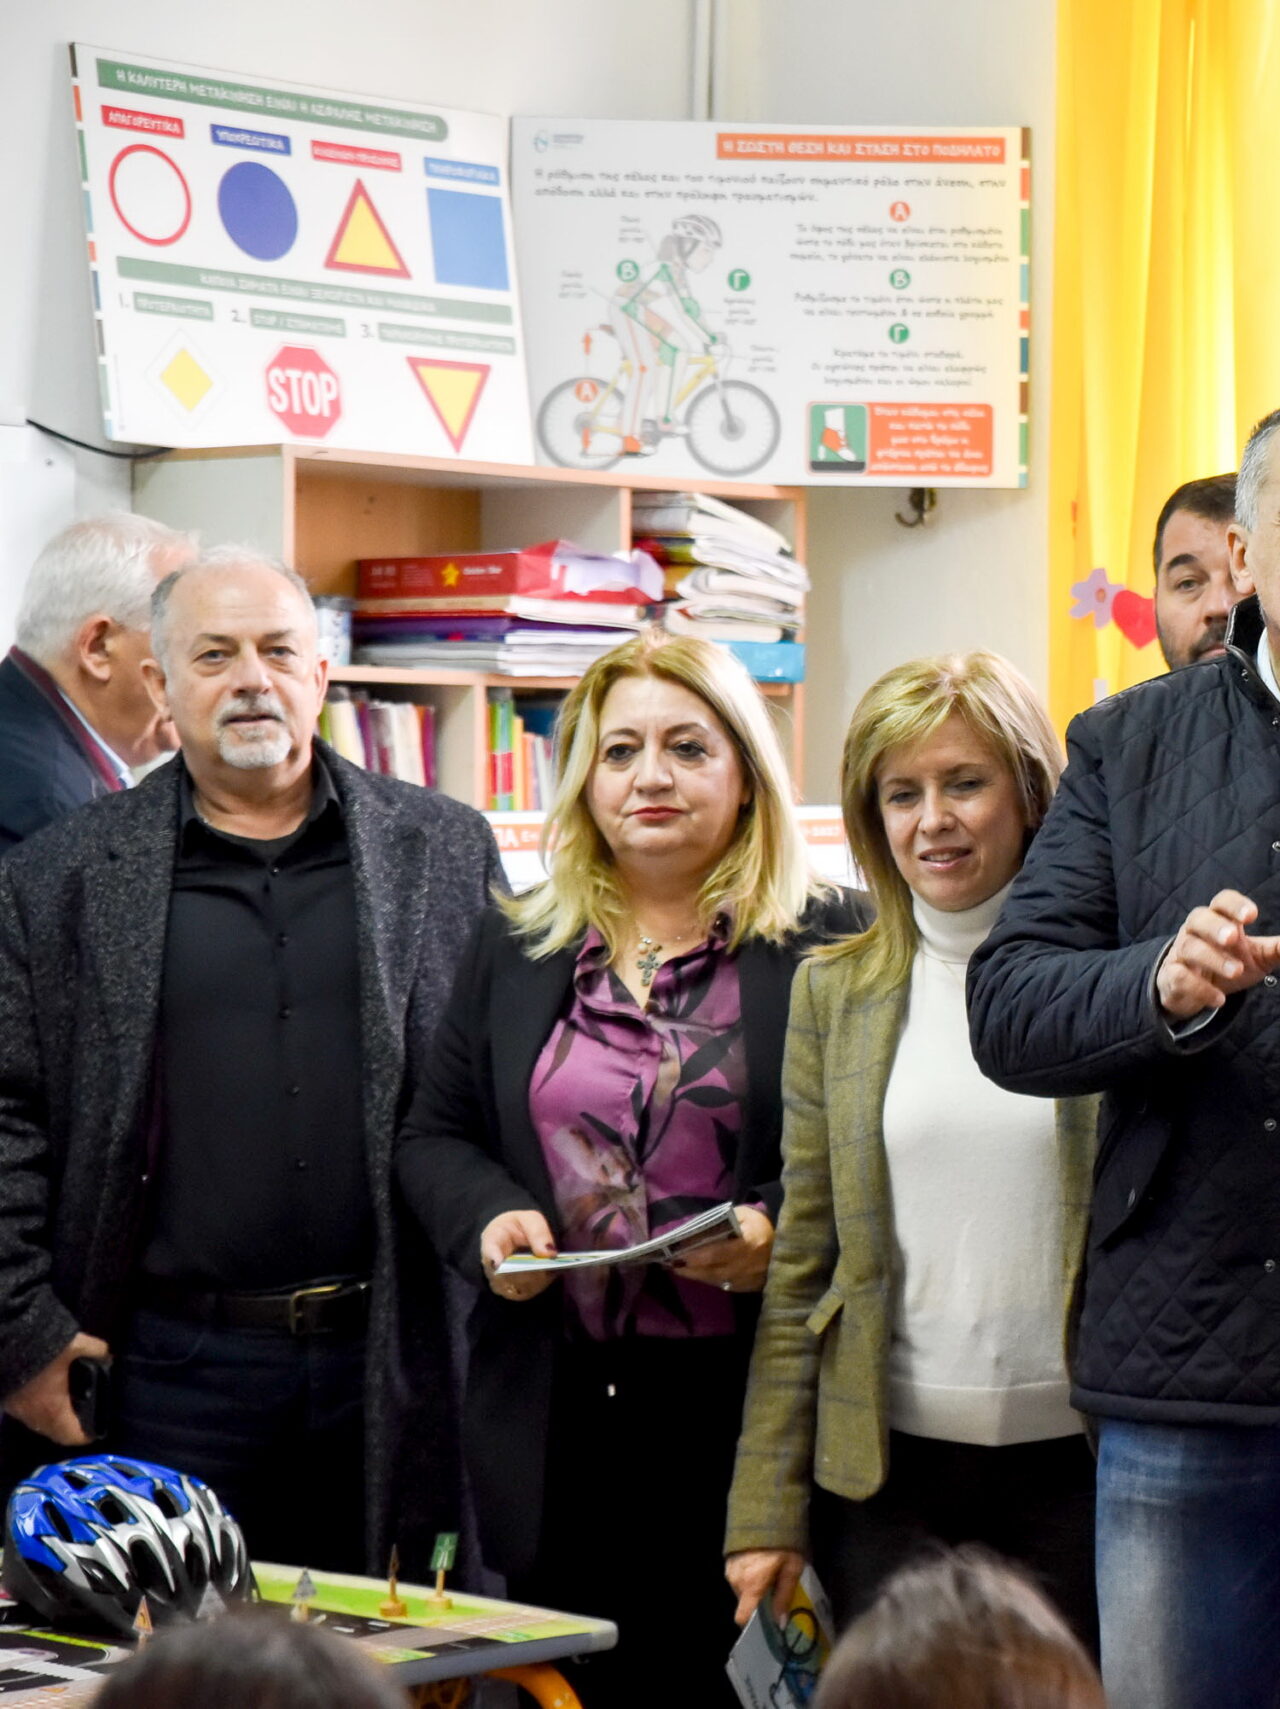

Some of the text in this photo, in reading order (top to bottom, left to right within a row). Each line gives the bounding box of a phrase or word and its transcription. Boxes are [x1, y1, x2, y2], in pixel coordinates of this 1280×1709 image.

[127, 71, 187, 94] ΚΑΛΥΤΕΡΗ
[108, 110, 180, 134] ΑΠΑΓΟΡΕΥΤΙΚΑ
[737, 140, 784, 154] ΣΩΣΤΗ
[788, 142, 824, 155] ΘΕΣΗ
[828, 142, 851, 155] ΚΑΙ
[855, 143, 899, 156] ΣΤΑΣΗ
[903, 144, 930, 156] ΣΤΟ
[933, 144, 1001, 156] ΠΟΔΗΛΑΤΟ
[268, 366, 339, 418] STOP
